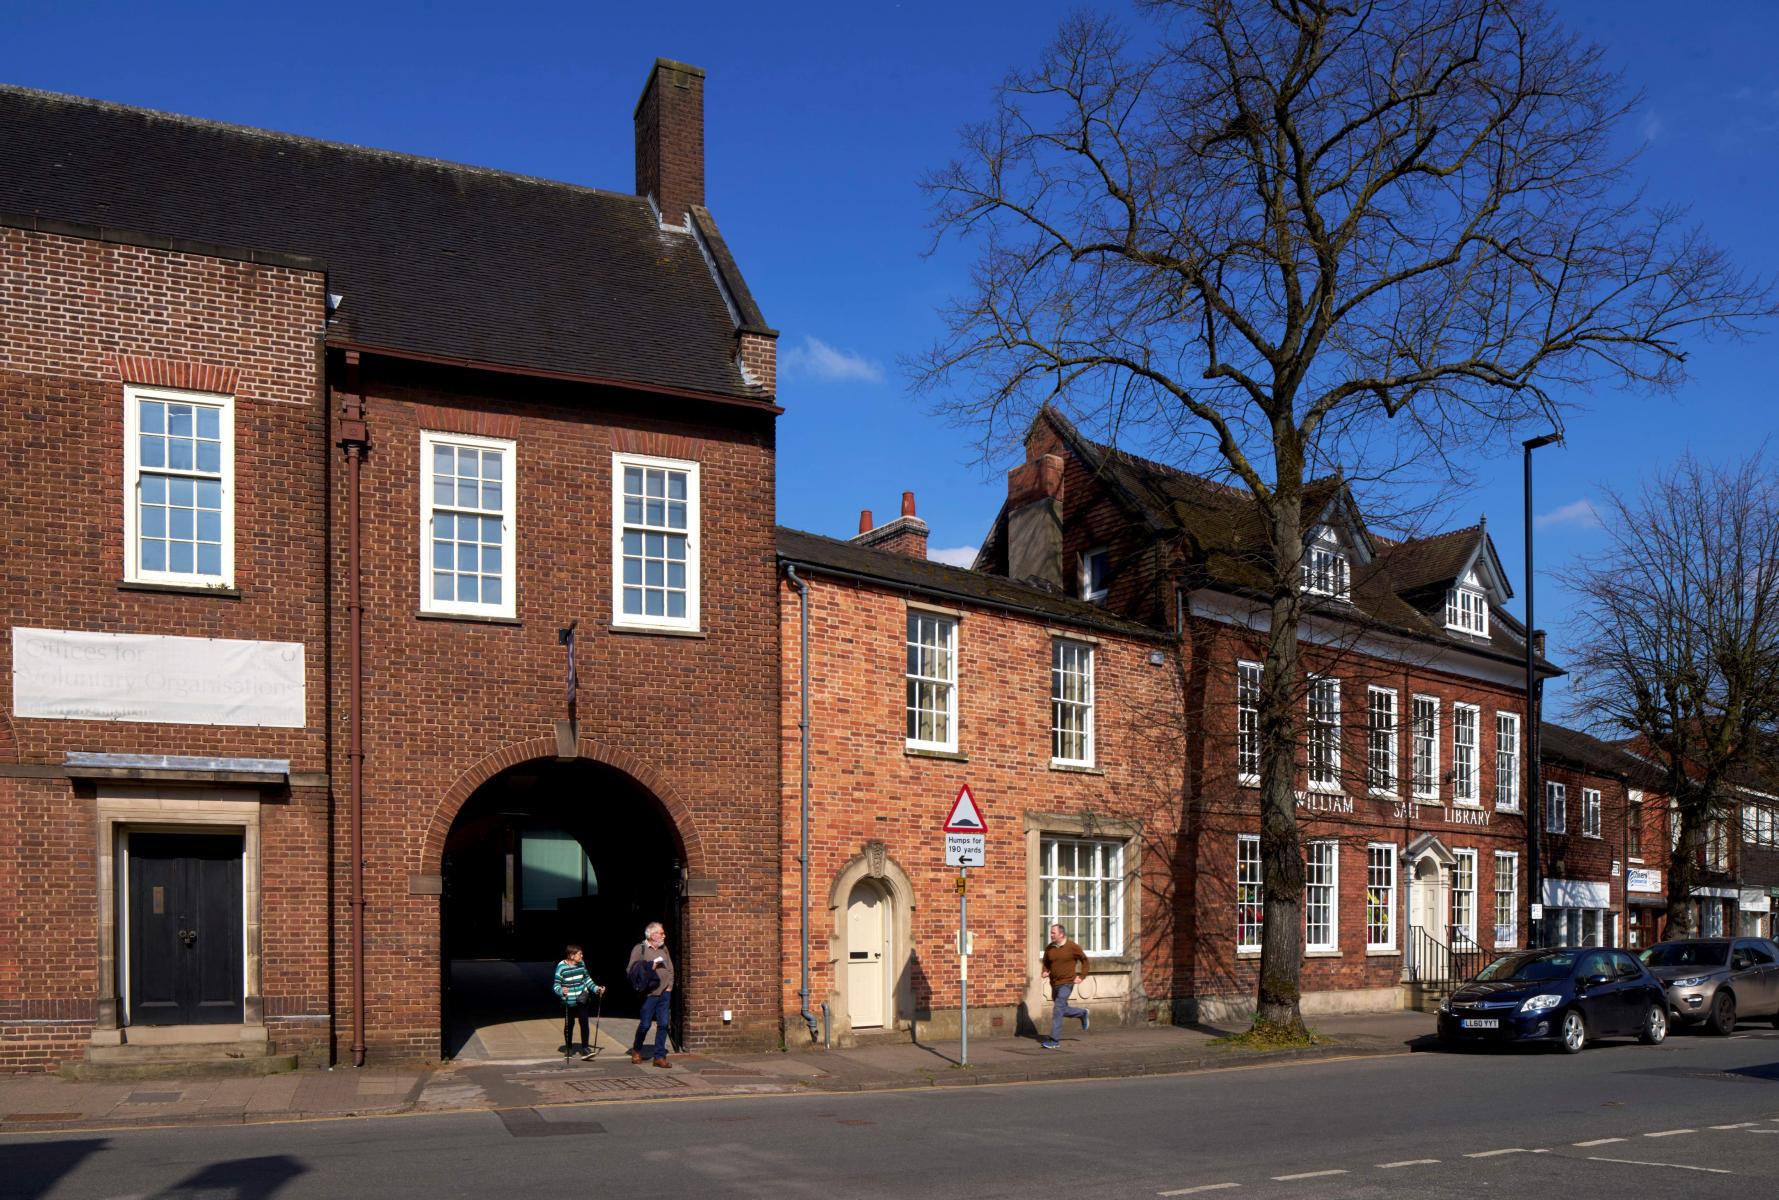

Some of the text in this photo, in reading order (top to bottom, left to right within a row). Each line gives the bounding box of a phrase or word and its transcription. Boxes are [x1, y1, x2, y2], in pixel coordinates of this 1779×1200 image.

[25, 637, 145, 662] Offices for
[1294, 791, 1353, 814] WILLIAM
[1444, 807, 1491, 826] LIBRARY
[949, 836, 970, 844] Humps
[964, 846, 982, 854] yards
